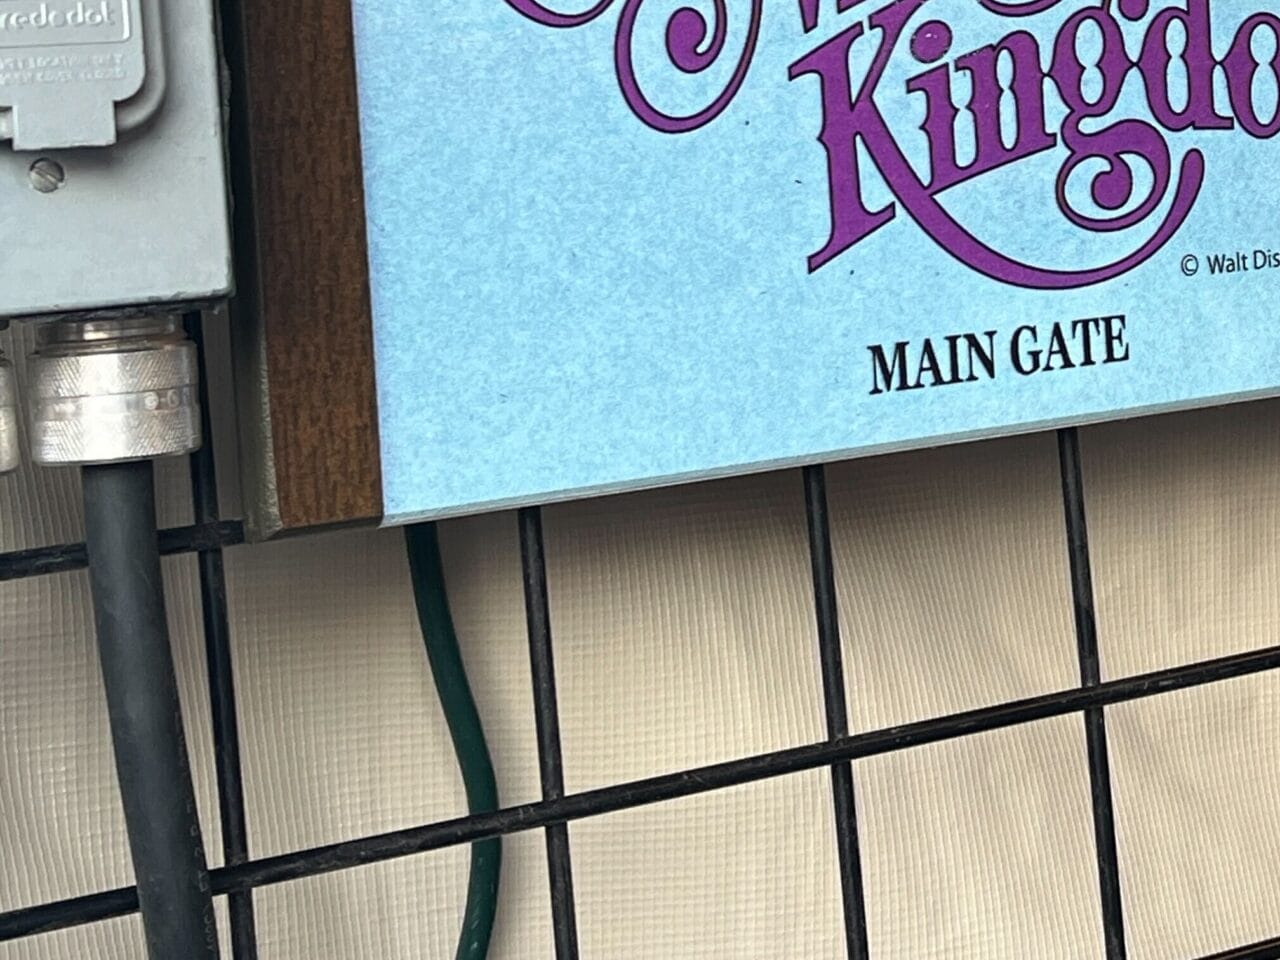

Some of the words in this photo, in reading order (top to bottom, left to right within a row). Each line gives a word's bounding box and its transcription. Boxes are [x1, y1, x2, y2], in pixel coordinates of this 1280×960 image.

[1206, 251, 1249, 275] Walt
[866, 330, 998, 395] MAIN
[1010, 314, 1130, 376] GATE
